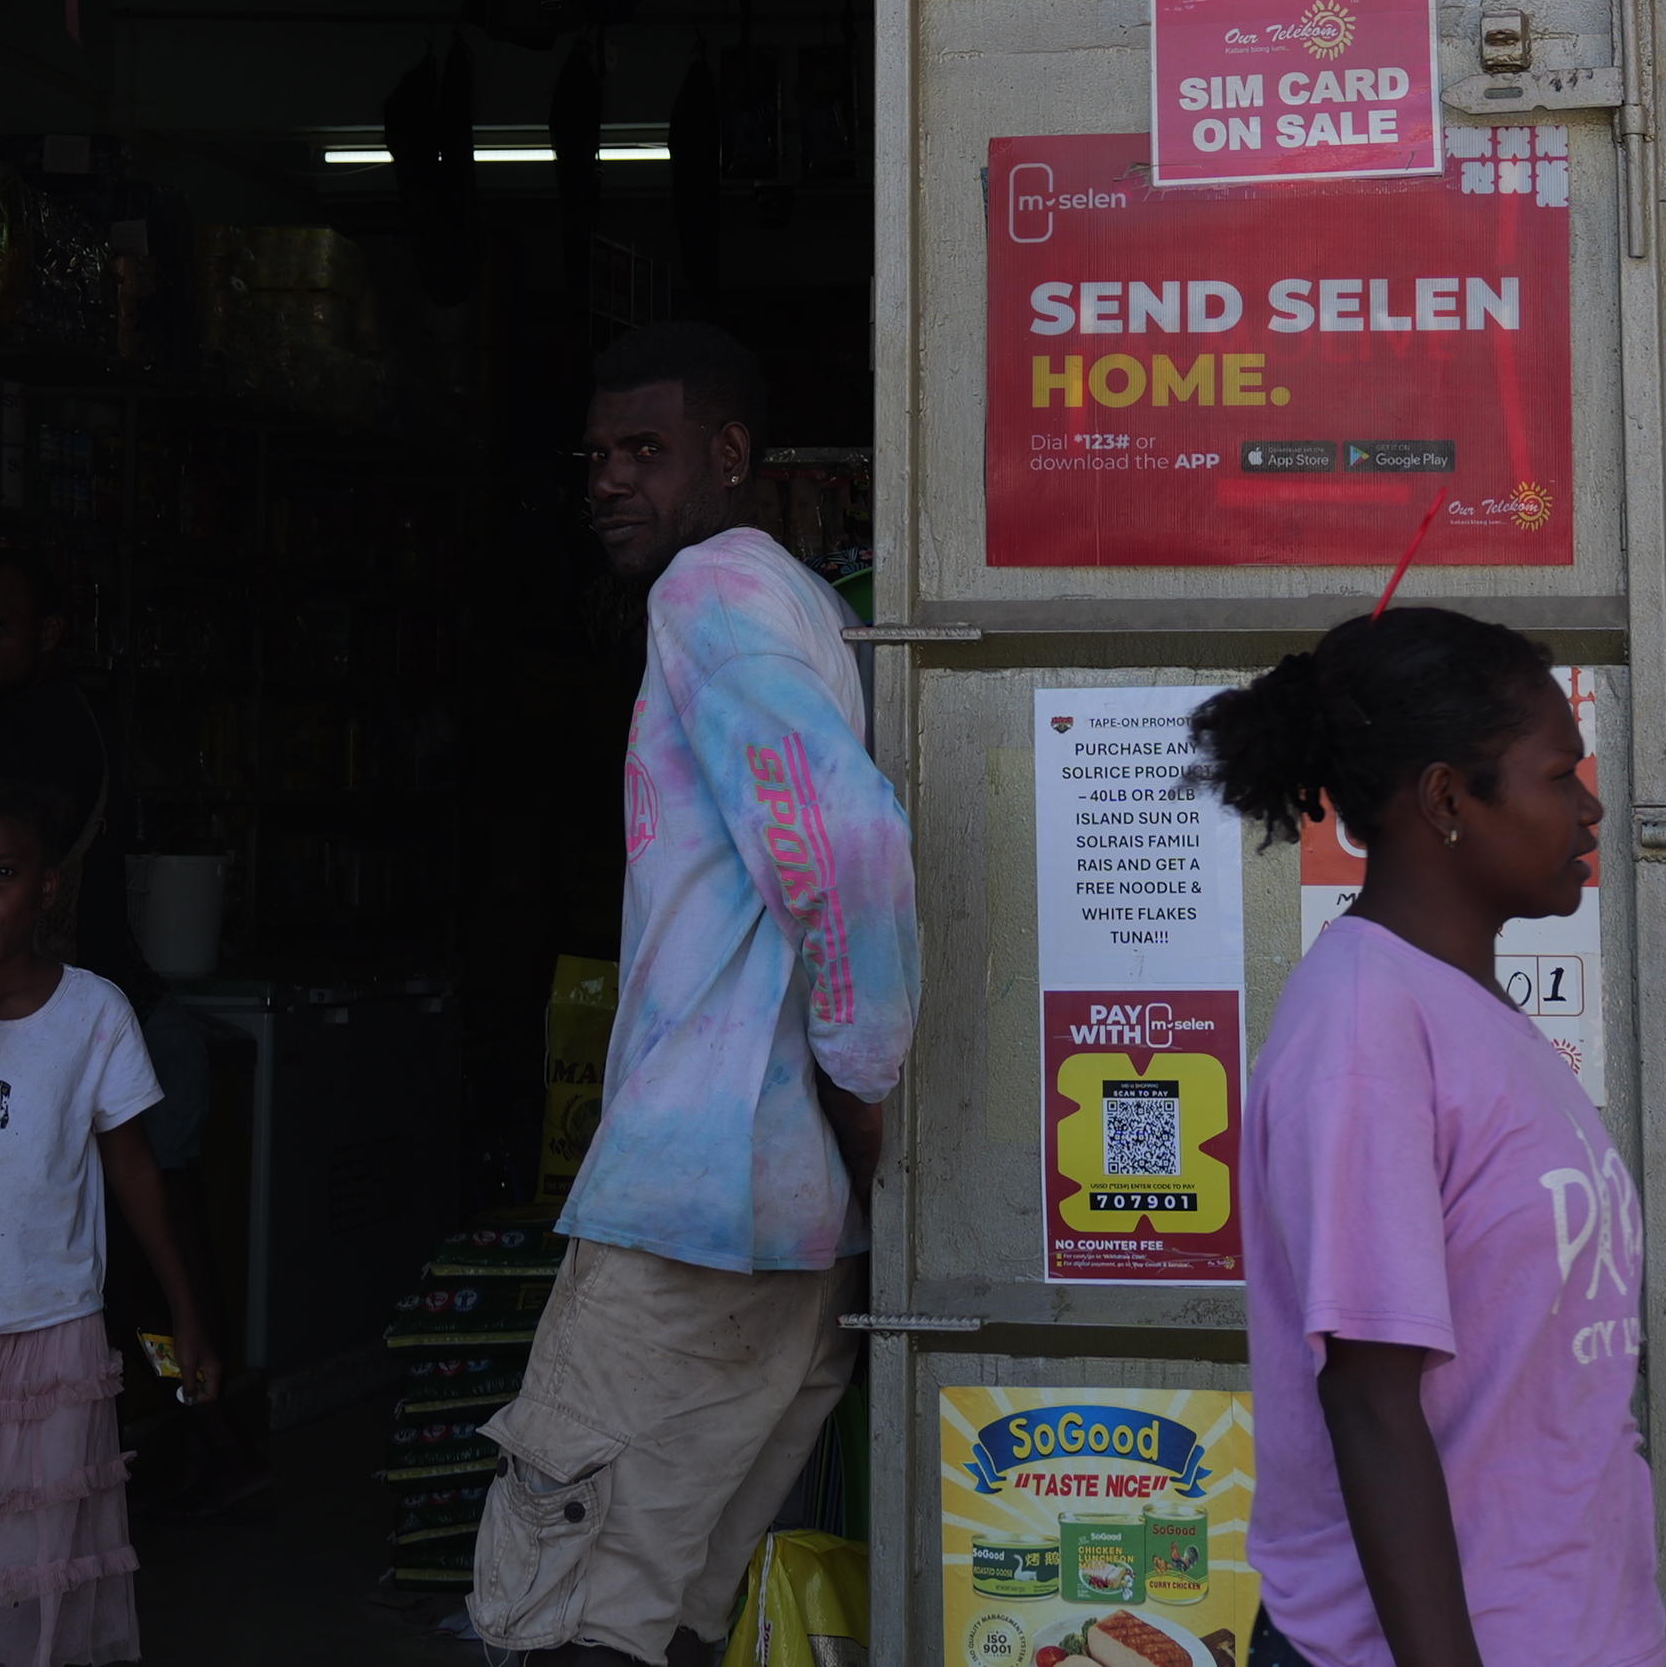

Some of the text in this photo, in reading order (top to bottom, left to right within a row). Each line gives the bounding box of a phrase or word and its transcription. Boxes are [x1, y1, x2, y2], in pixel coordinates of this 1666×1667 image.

[1225, 22, 1338, 44] Our Telekom
[1178, 68, 1408, 111] SIM CARD
[1192, 110, 1398, 152] ON SALE
[1030, 277, 1519, 335] SEND SELEN
[1033, 353, 1291, 408] HOME.
[1031, 434, 1068, 450] Dial
[1136, 437, 1155, 449] or
[1030, 453, 1220, 470] download the APP
[1268, 454, 1329, 468] App Store
[1376, 454, 1448, 468] Google Play
[1448, 497, 1539, 516] Our Telekom
[1089, 718, 1139, 728] TAPE-ON
[1075, 742, 1198, 756] PURCHASE ANY
[1062, 767, 1130, 779] SOLRICE
[1090, 788, 1195, 802] 40LB OR 20LB
[1076, 812, 1199, 825] ISLAND SUN OR
[1076, 835, 1199, 848] SOLRAIS FAMILI
[1077, 858, 1200, 871] RAIS AND GET A
[1076, 882, 1202, 894] FREE NOODLE &
[1082, 907, 1197, 920] WHITE FLAKES
[1111, 931, 1169, 944] TUNA!!!
[1090, 1005, 1142, 1024] PAY
[1070, 1025, 1141, 1044] WITH
[1055, 1240, 1163, 1251] NO COUNTER FEE
[1009, 1412, 1160, 1462] SoGood
[1153, 1524, 1197, 1536] SoGood
[1149, 1580, 1201, 1591] CURRY CHICKEN
[987, 1635, 1007, 1644] ISO
[984, 1645, 1012, 1654] 9001
